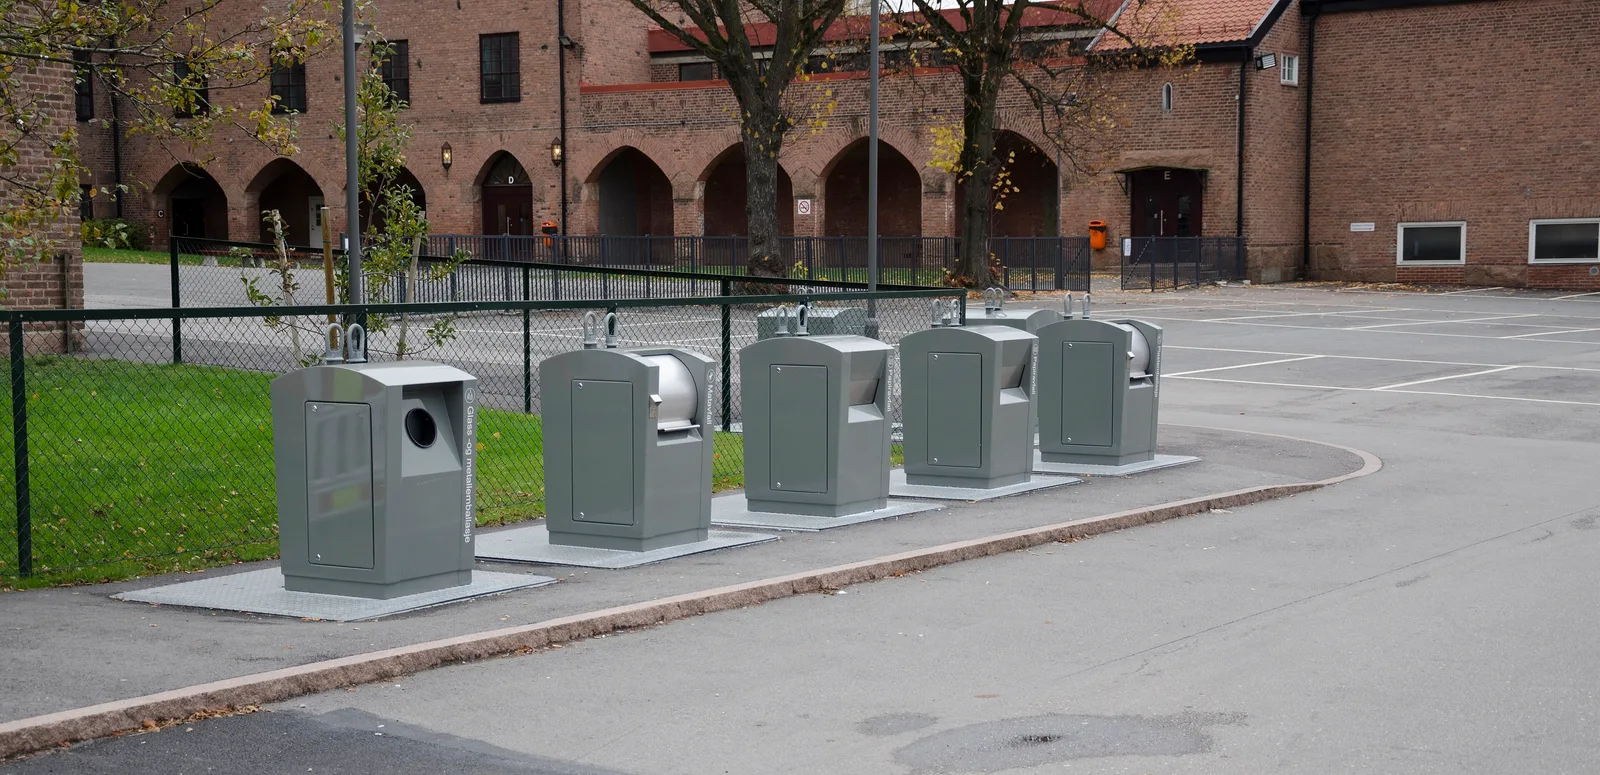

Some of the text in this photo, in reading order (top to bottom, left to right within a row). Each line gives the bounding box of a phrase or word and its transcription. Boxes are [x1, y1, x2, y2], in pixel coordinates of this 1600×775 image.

[508, 176, 515, 184] D
[1164, 171, 1171, 180] E
[158, 210, 164, 218] C
[706, 384, 714, 425] Matavfall
[466, 405, 474, 436] Glass
[463, 458, 473, 543] metallemballasje
